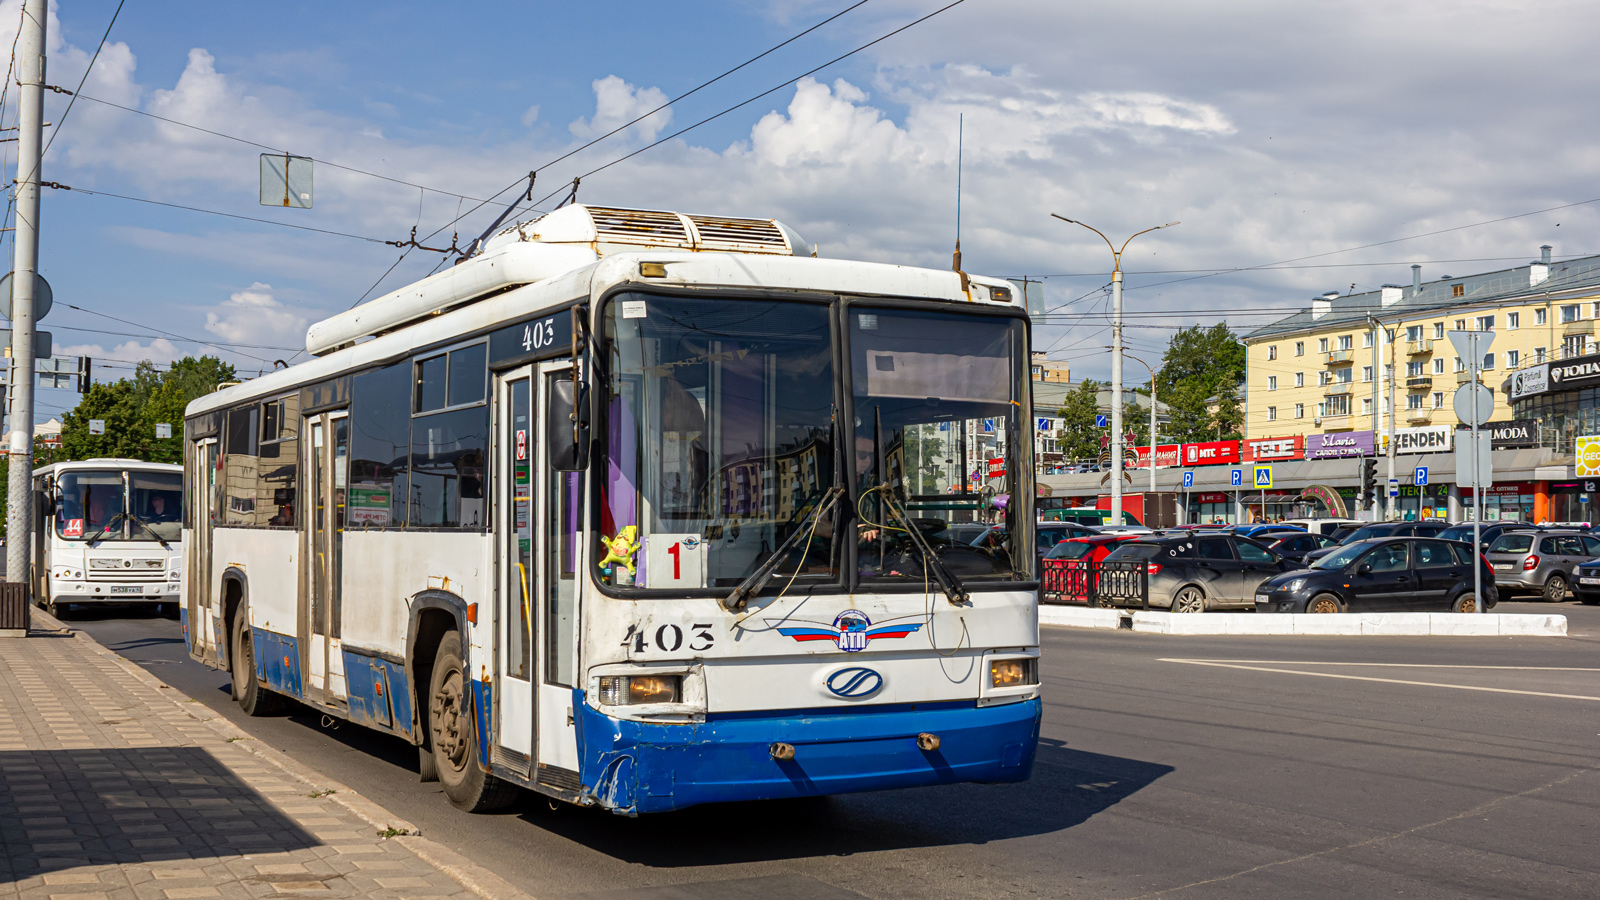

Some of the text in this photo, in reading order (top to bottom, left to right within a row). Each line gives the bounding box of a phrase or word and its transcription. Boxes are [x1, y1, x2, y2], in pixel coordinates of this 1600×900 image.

[521, 318, 554, 352] 403
[1561, 363, 1600, 378] ТОПА
[1394, 430, 1446, 449] ZENDEN
[1139, 449, 1177, 462] ШАМАНИЯ
[1199, 448, 1216, 458] МТС
[1249, 439, 1295, 459] ТВОЕ
[1315, 449, 1338, 457] САЛОН
[1398, 485, 1449, 497] ТЕКА 24
[66, 520, 81, 532] 44
[667, 542, 681, 580] 1
[620, 623, 715, 653] 403
[838, 632, 866, 649] АТП
